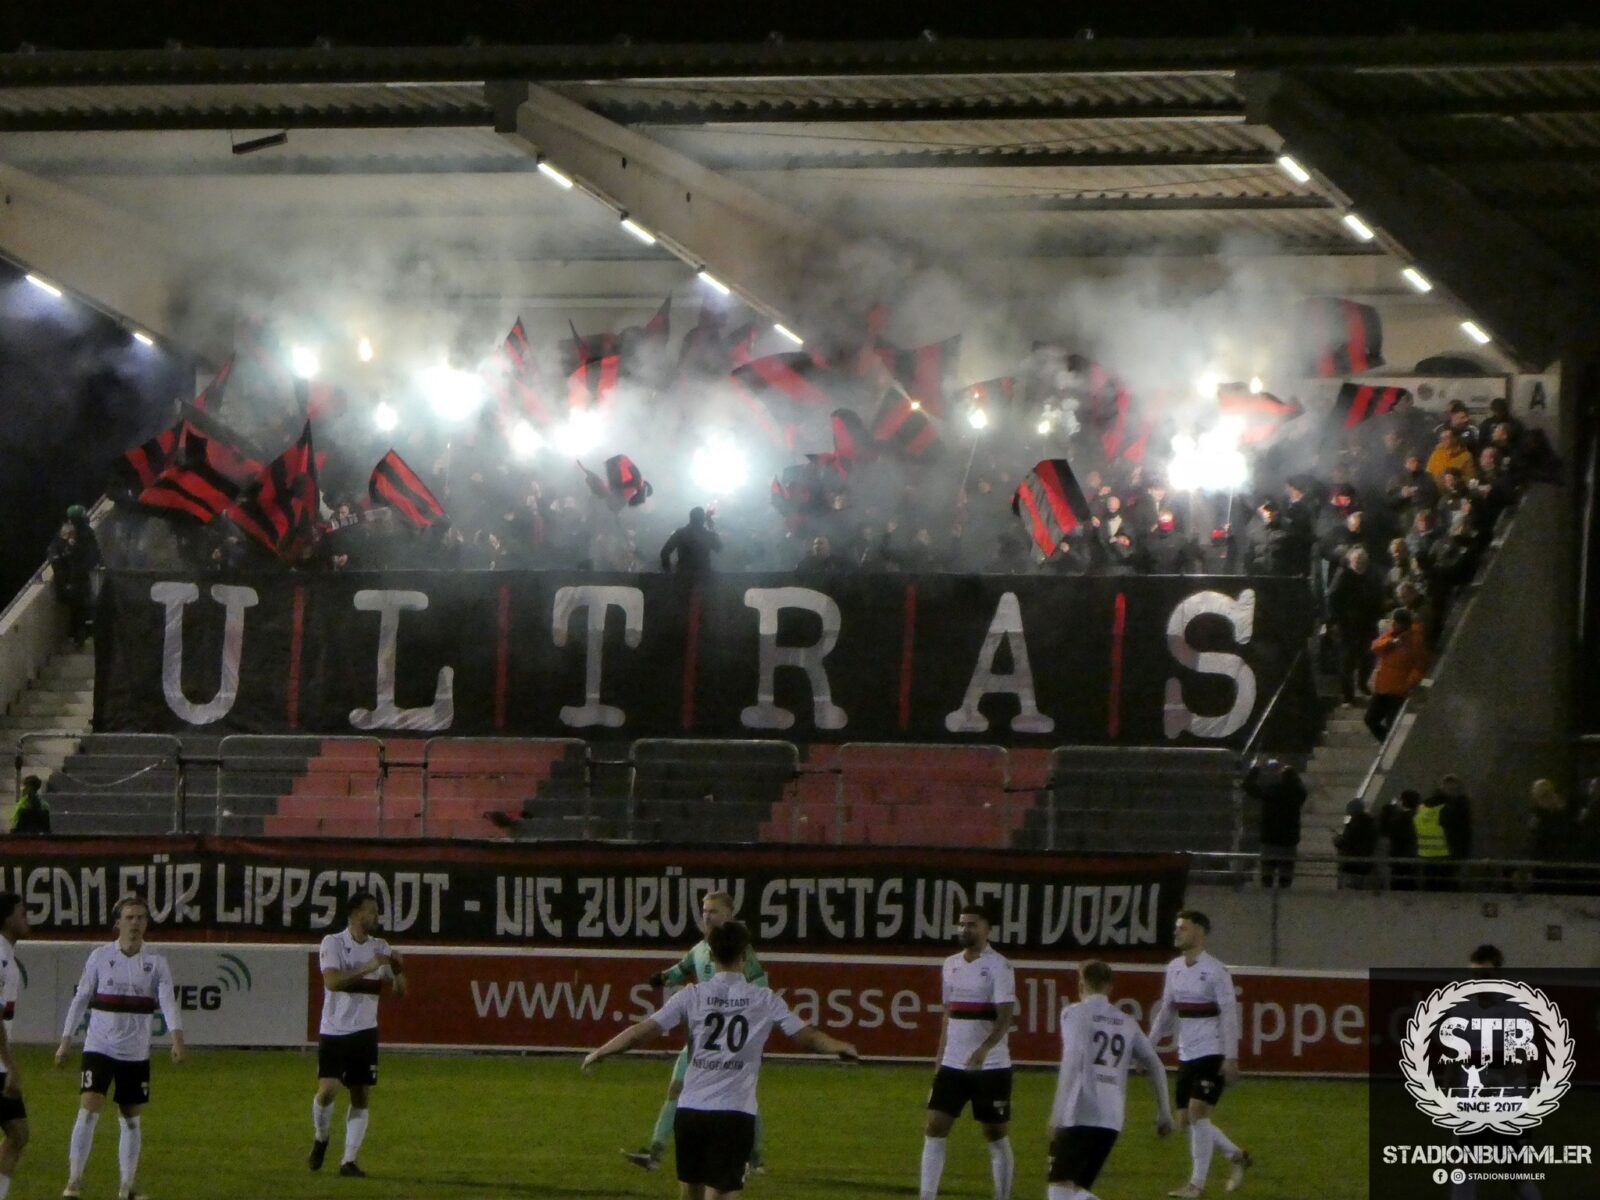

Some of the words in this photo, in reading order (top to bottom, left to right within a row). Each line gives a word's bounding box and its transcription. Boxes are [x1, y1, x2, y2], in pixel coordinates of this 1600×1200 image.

[119, 854, 202, 924] FÜR
[216, 863, 450, 934] LIPPSTADT
[496, 876, 563, 938] NIE
[760, 878, 903, 940] STETS
[1041, 883, 1161, 946] VORN
[703, 1012, 749, 1053] 20
[1092, 1030, 1126, 1068] 29
